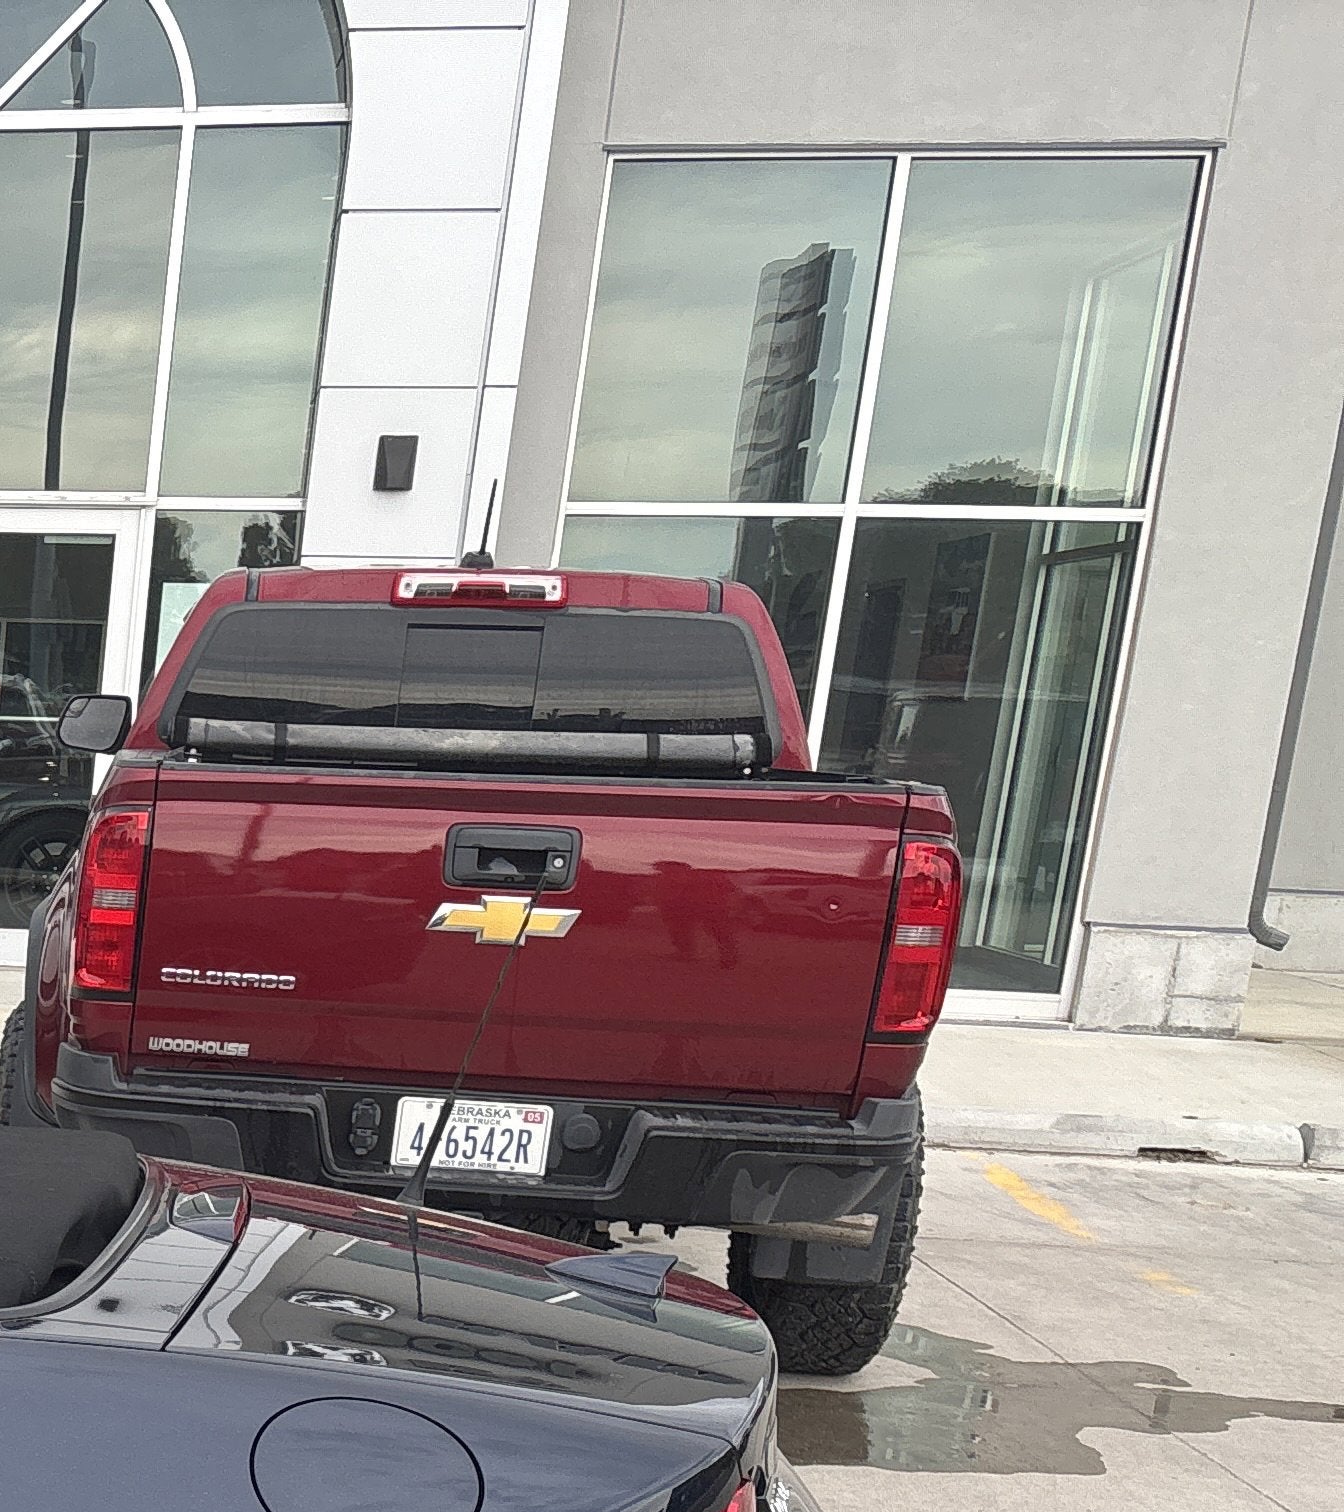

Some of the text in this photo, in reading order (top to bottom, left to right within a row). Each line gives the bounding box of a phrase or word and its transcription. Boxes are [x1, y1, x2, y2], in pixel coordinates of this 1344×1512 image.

[160, 967, 297, 991] COLORADO
[148, 1036, 251, 1058] WOODHOUSE
[441, 1105, 512, 1120] EBRASKA
[527, 1112, 541, 1122] 05
[450, 1117, 502, 1127] ARM TRUCK
[409, 1121, 533, 1165] 46542R
